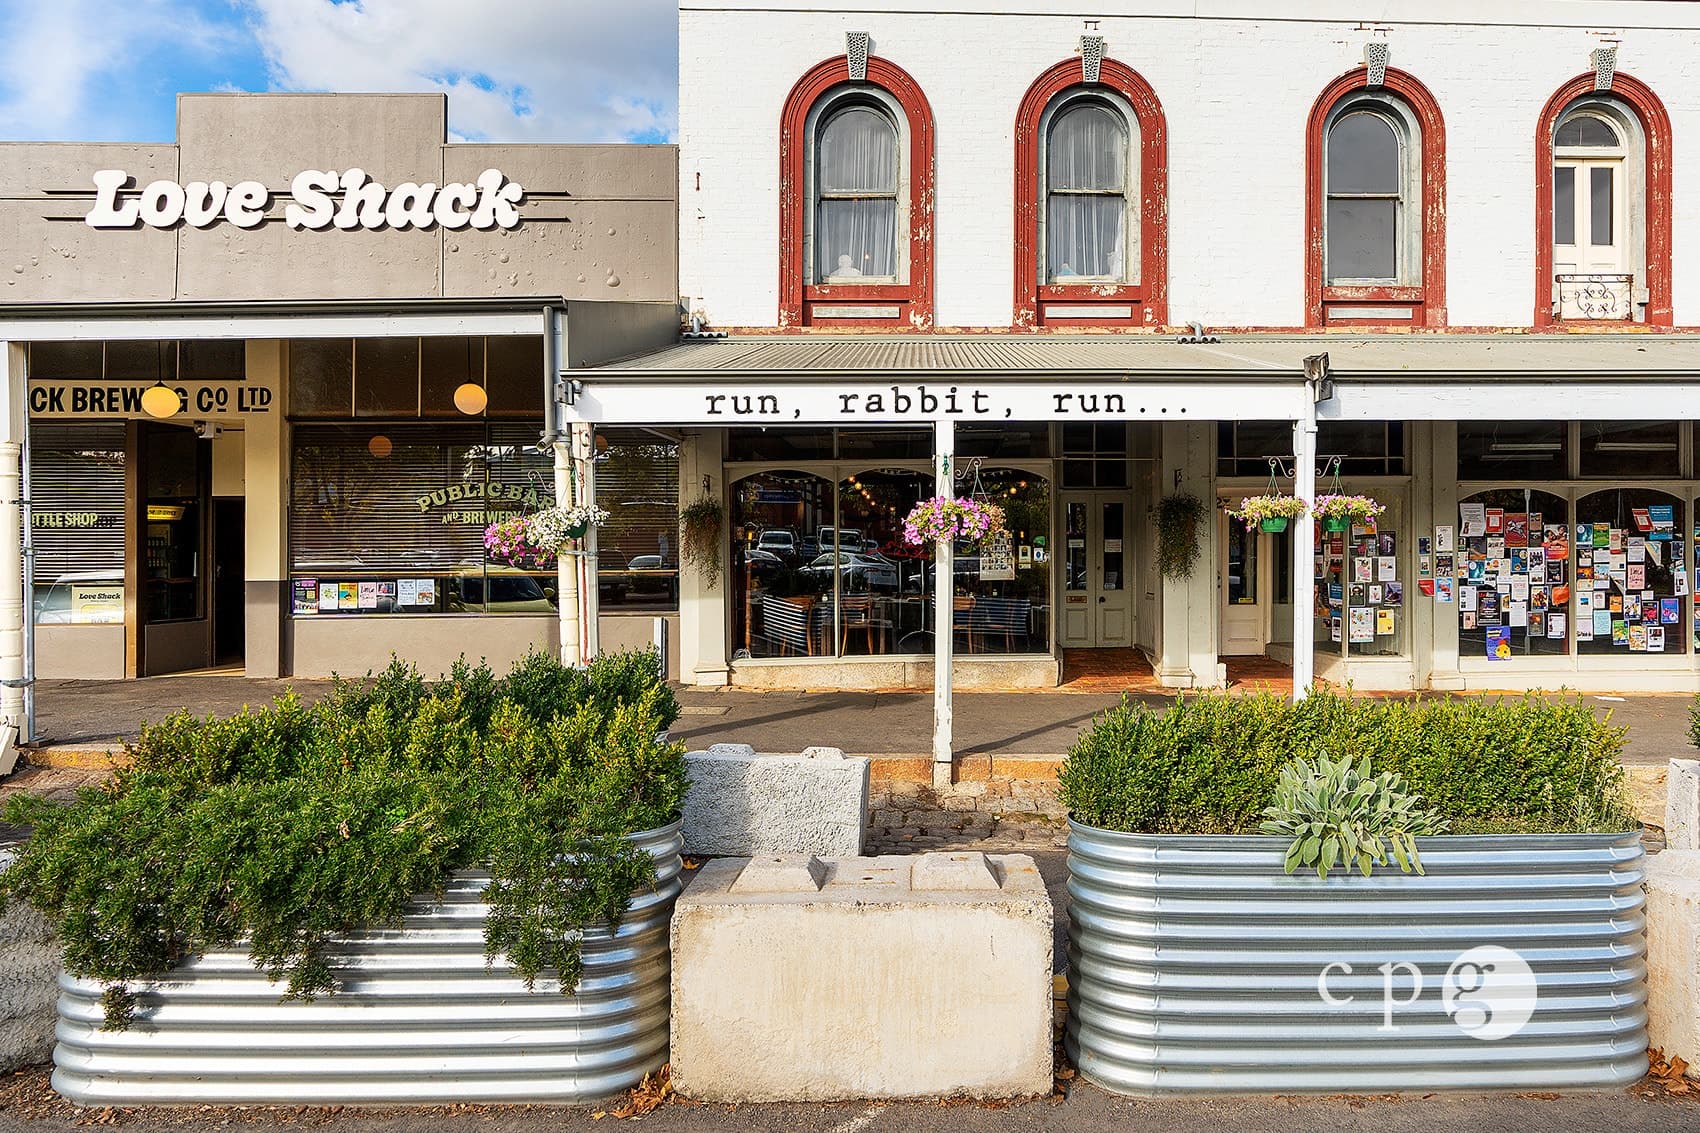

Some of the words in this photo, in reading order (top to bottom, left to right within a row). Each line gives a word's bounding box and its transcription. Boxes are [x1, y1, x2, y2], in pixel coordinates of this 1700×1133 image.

[85, 169, 267, 228] Love
[285, 167, 523, 229] Shack
[72, 386, 188, 412] BREWG
[705, 391, 801, 418] run,
[839, 386, 1014, 418] rabbit,
[1053, 392, 1188, 413] run...
[416, 482, 503, 513] PUBLIC
[507, 484, 555, 510] BAR
[31, 512, 63, 526] TTLE
[65, 512, 98, 526] SHOP
